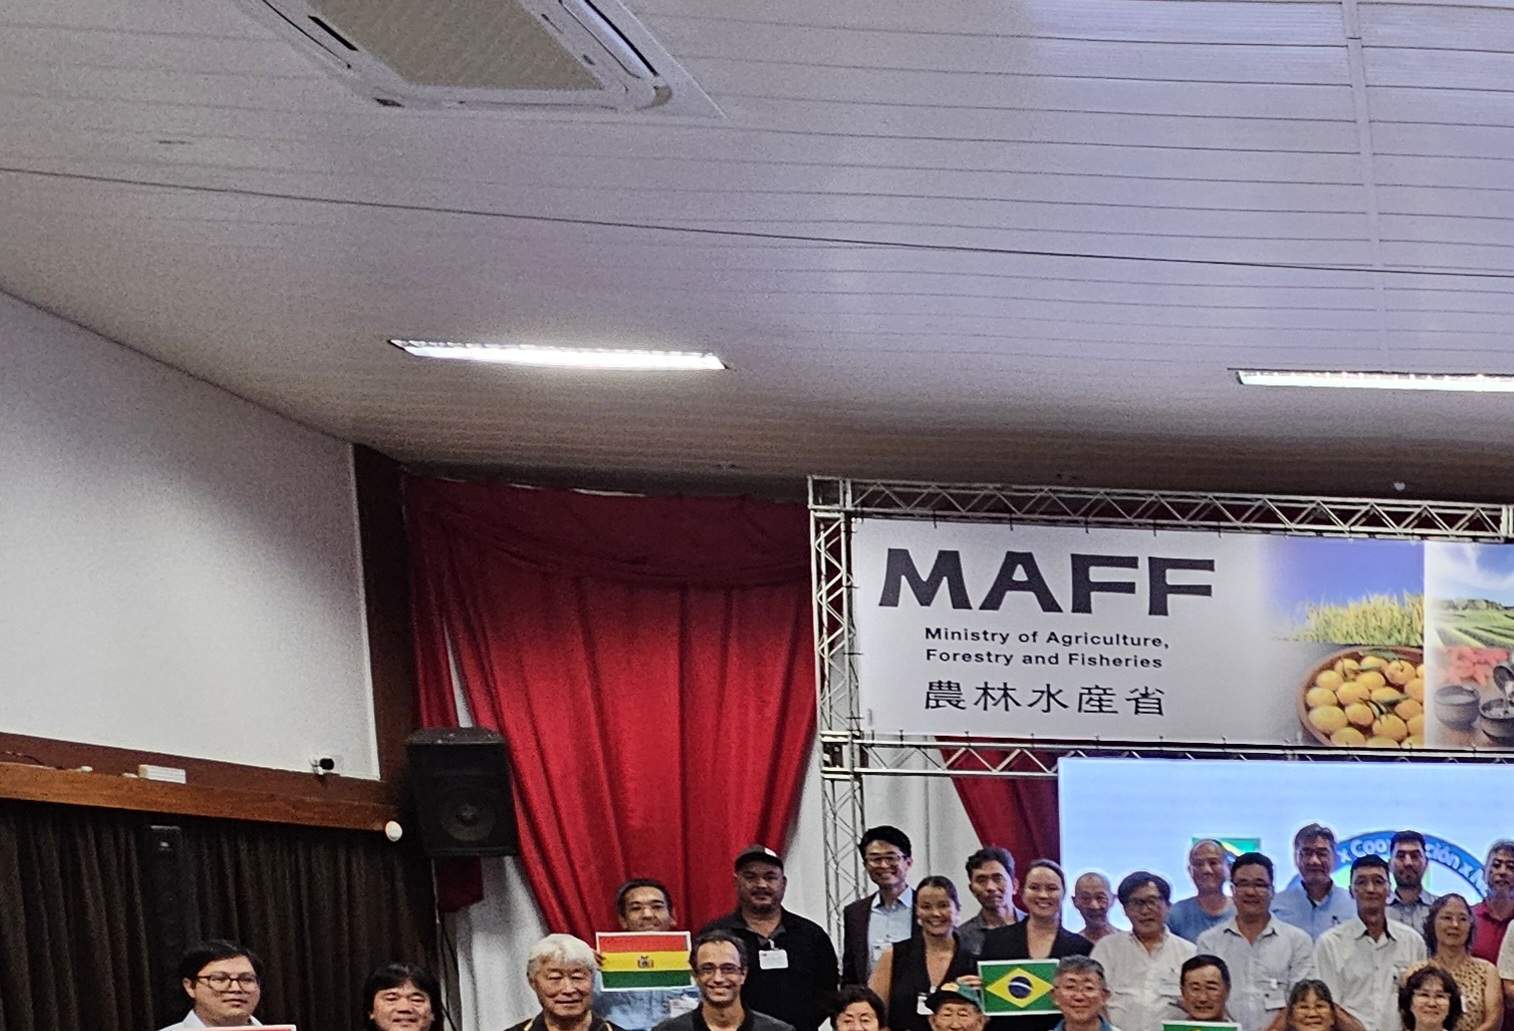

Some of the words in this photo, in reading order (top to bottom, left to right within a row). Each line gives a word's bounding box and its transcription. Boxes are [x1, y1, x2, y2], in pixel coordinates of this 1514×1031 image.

[878, 547, 1216, 617] MAFF
[925, 627, 1010, 645] Ministry
[1018, 630, 1039, 643] of
[1045, 631, 1169, 650] Agriculture,
[926, 648, 1014, 667] Forestry
[1022, 652, 1060, 666] and
[1068, 652, 1163, 669] Fisheries
[924, 679, 1166, 717] 農林水産省
